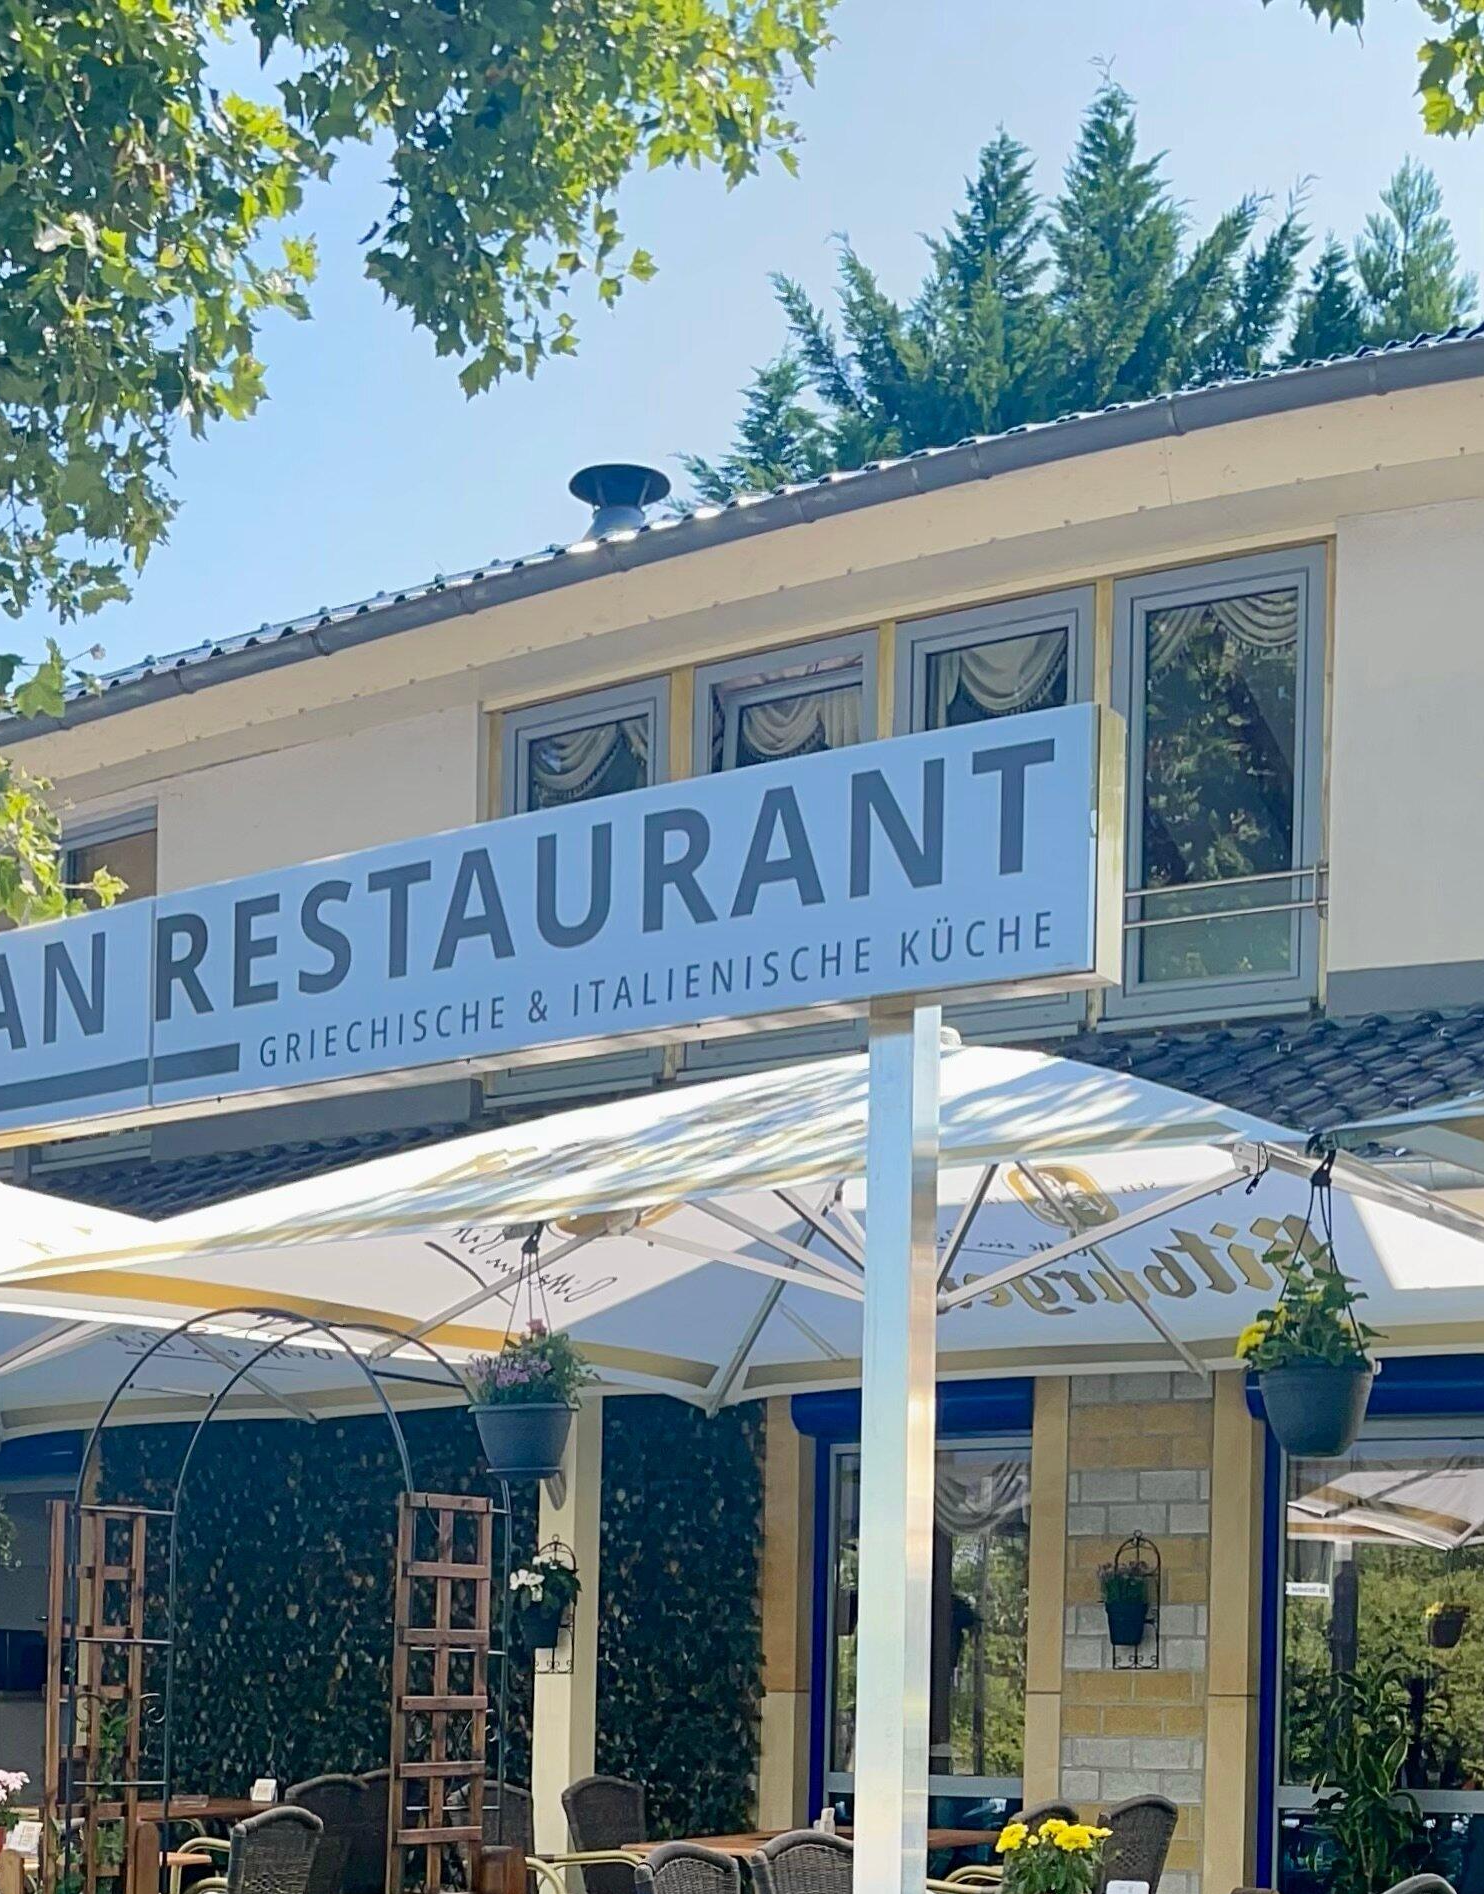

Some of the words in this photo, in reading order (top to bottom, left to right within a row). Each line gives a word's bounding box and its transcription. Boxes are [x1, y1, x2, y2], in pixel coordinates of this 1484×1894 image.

[154, 737, 1056, 1023] RESTAURANT
[258, 996, 504, 1068] GRIECHISCHE
[527, 989, 548, 1023] &
[572, 936, 872, 1017] ITALIENISCHE
[900, 910, 1053, 968] KÜCHE
